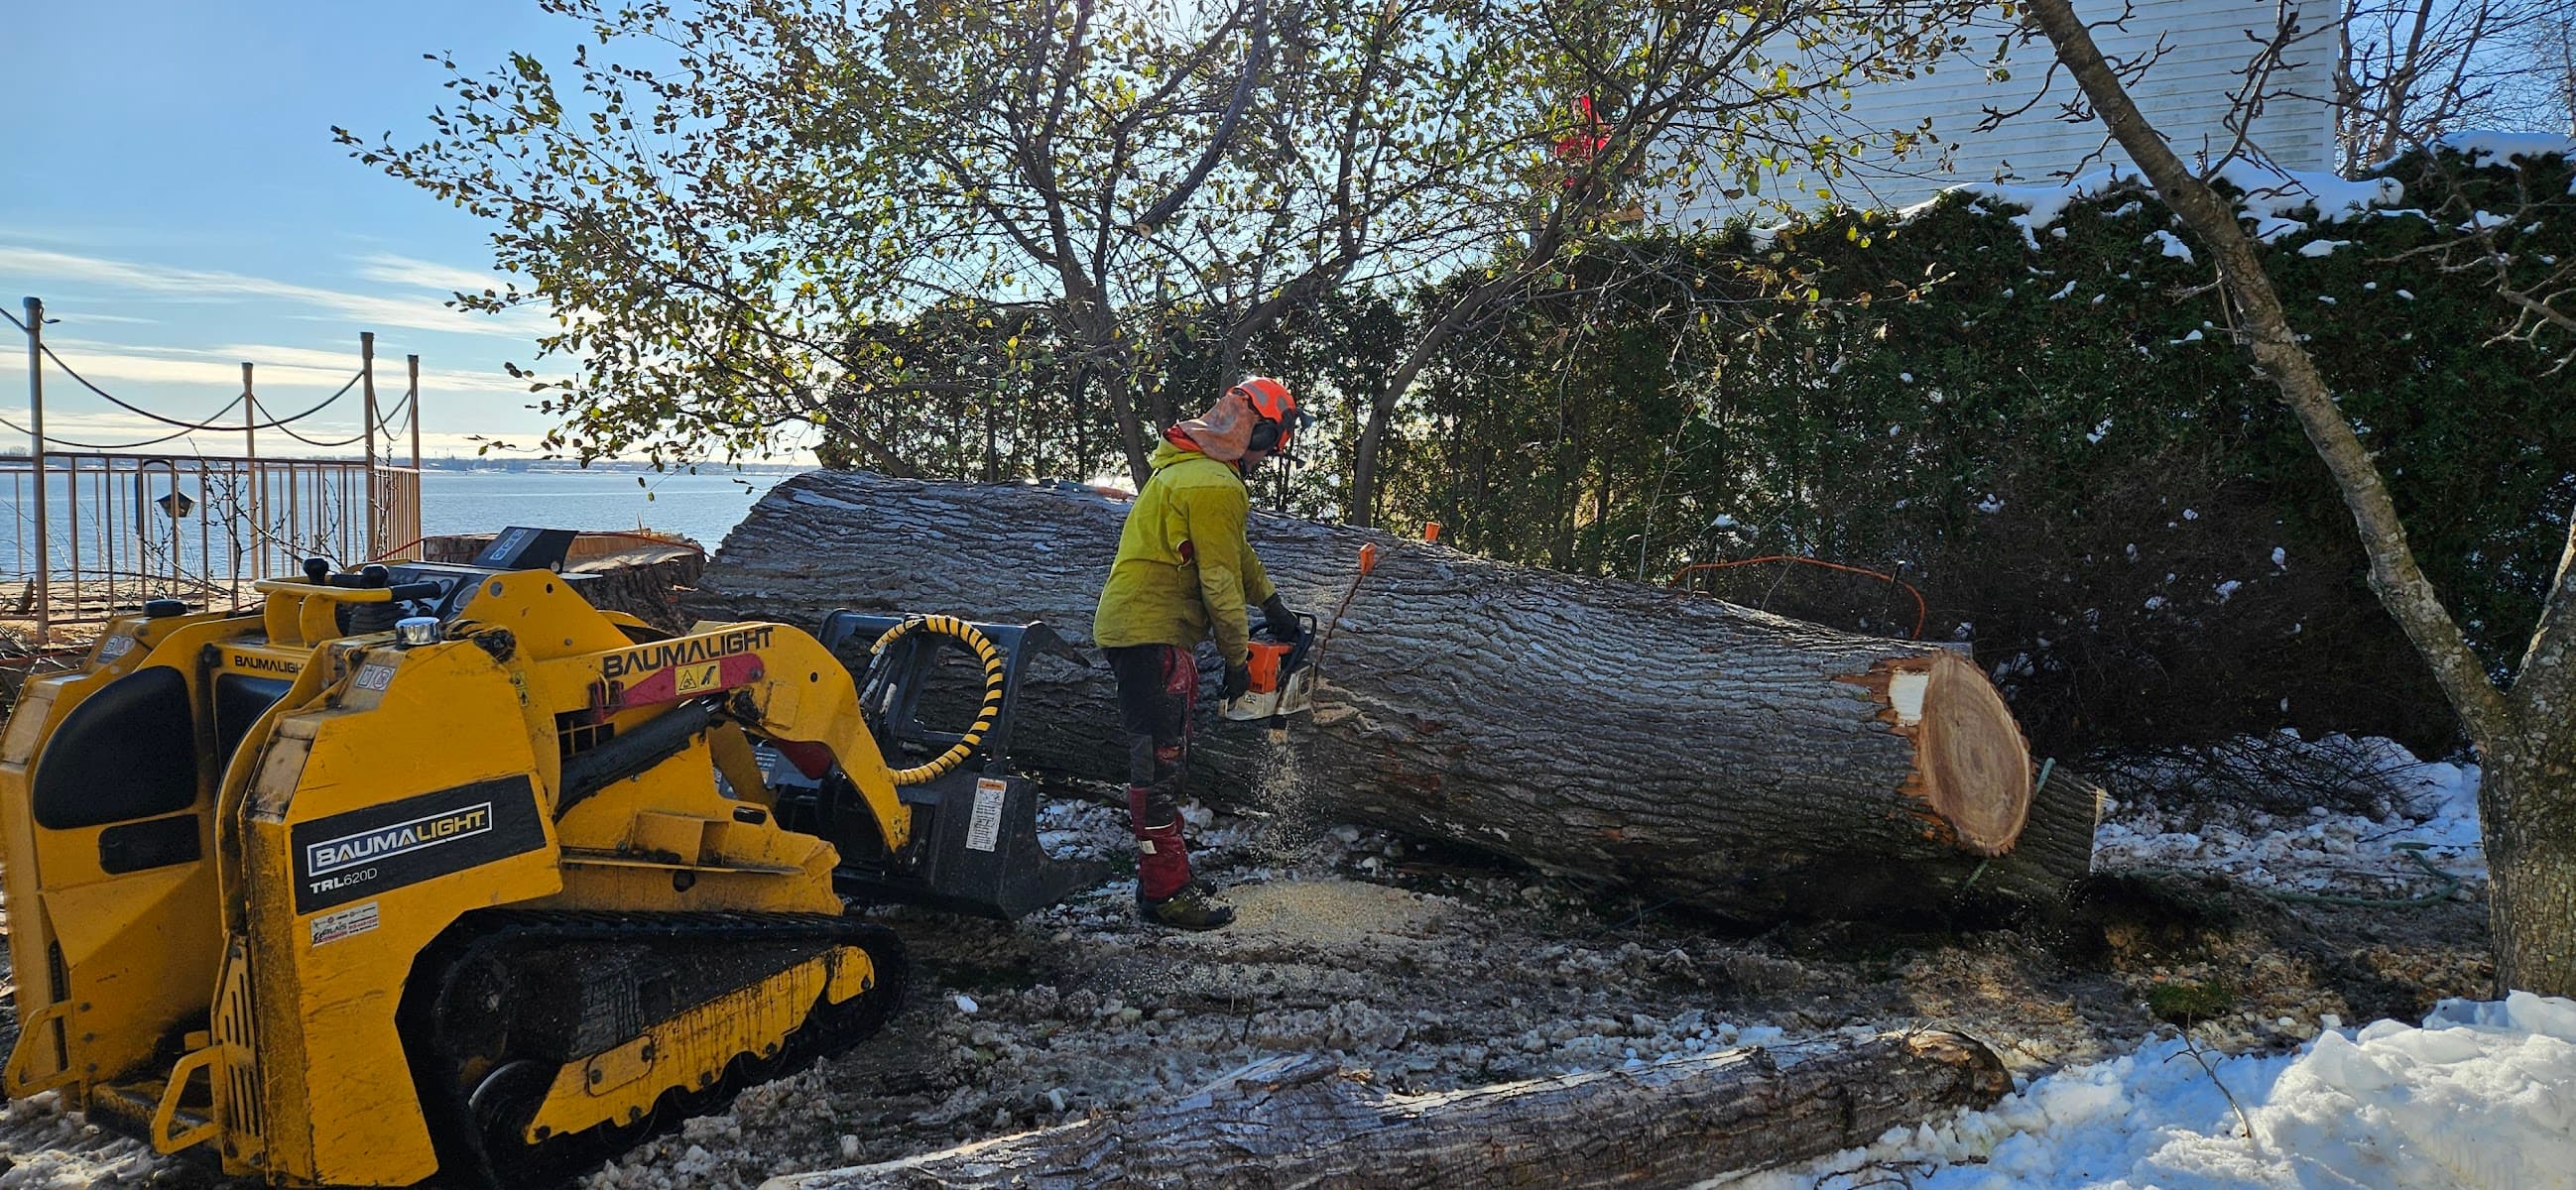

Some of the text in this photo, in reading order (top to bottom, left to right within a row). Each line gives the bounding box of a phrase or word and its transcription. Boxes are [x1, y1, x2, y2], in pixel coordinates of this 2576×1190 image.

[234, 654, 305, 674] BAUMALIGH
[603, 627, 774, 679] BAUMALIGHT
[316, 810, 485, 868] BAUMALIGHT
[309, 867, 378, 893] TRL620D
